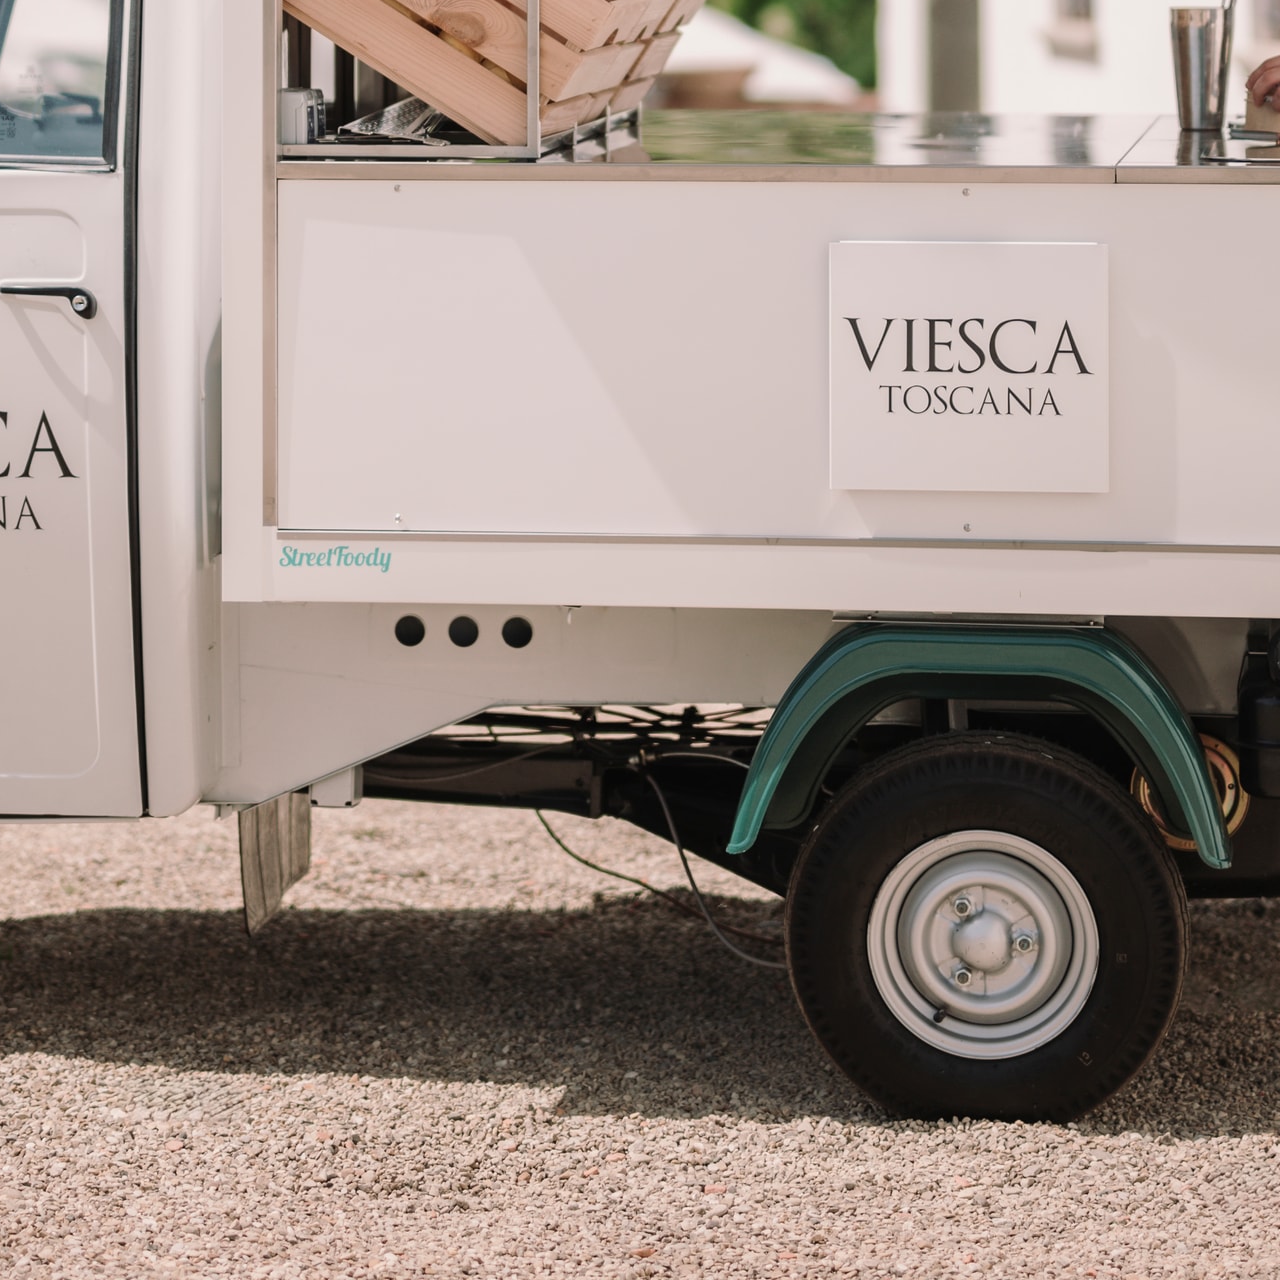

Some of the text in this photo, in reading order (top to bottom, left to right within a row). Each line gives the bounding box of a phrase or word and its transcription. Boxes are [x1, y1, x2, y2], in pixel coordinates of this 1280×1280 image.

[842, 317, 1095, 375] VIESCA
[879, 384, 1064, 416] TOSCANA
[279, 545, 392, 573] StreetFoody
